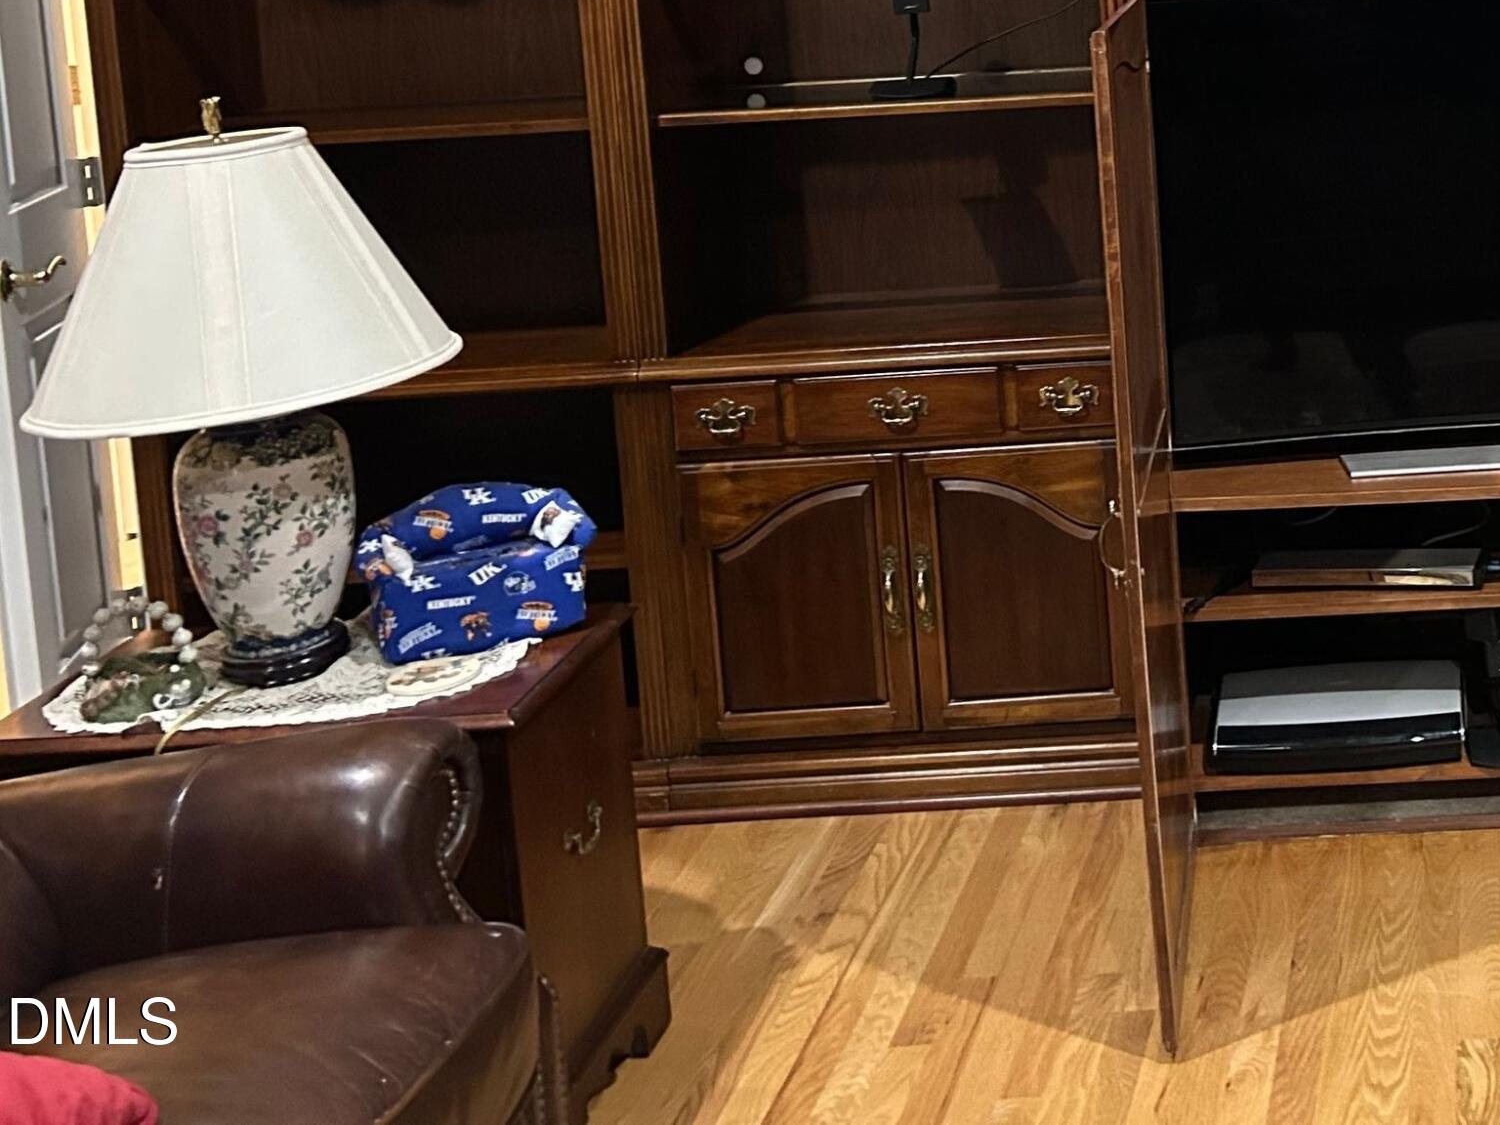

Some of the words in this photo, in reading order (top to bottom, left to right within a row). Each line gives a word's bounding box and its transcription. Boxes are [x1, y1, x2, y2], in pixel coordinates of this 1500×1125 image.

[482, 513, 523, 524] KENTUCKY
[468, 562, 503, 586] UK
[427, 597, 472, 610] KENTUCKY
